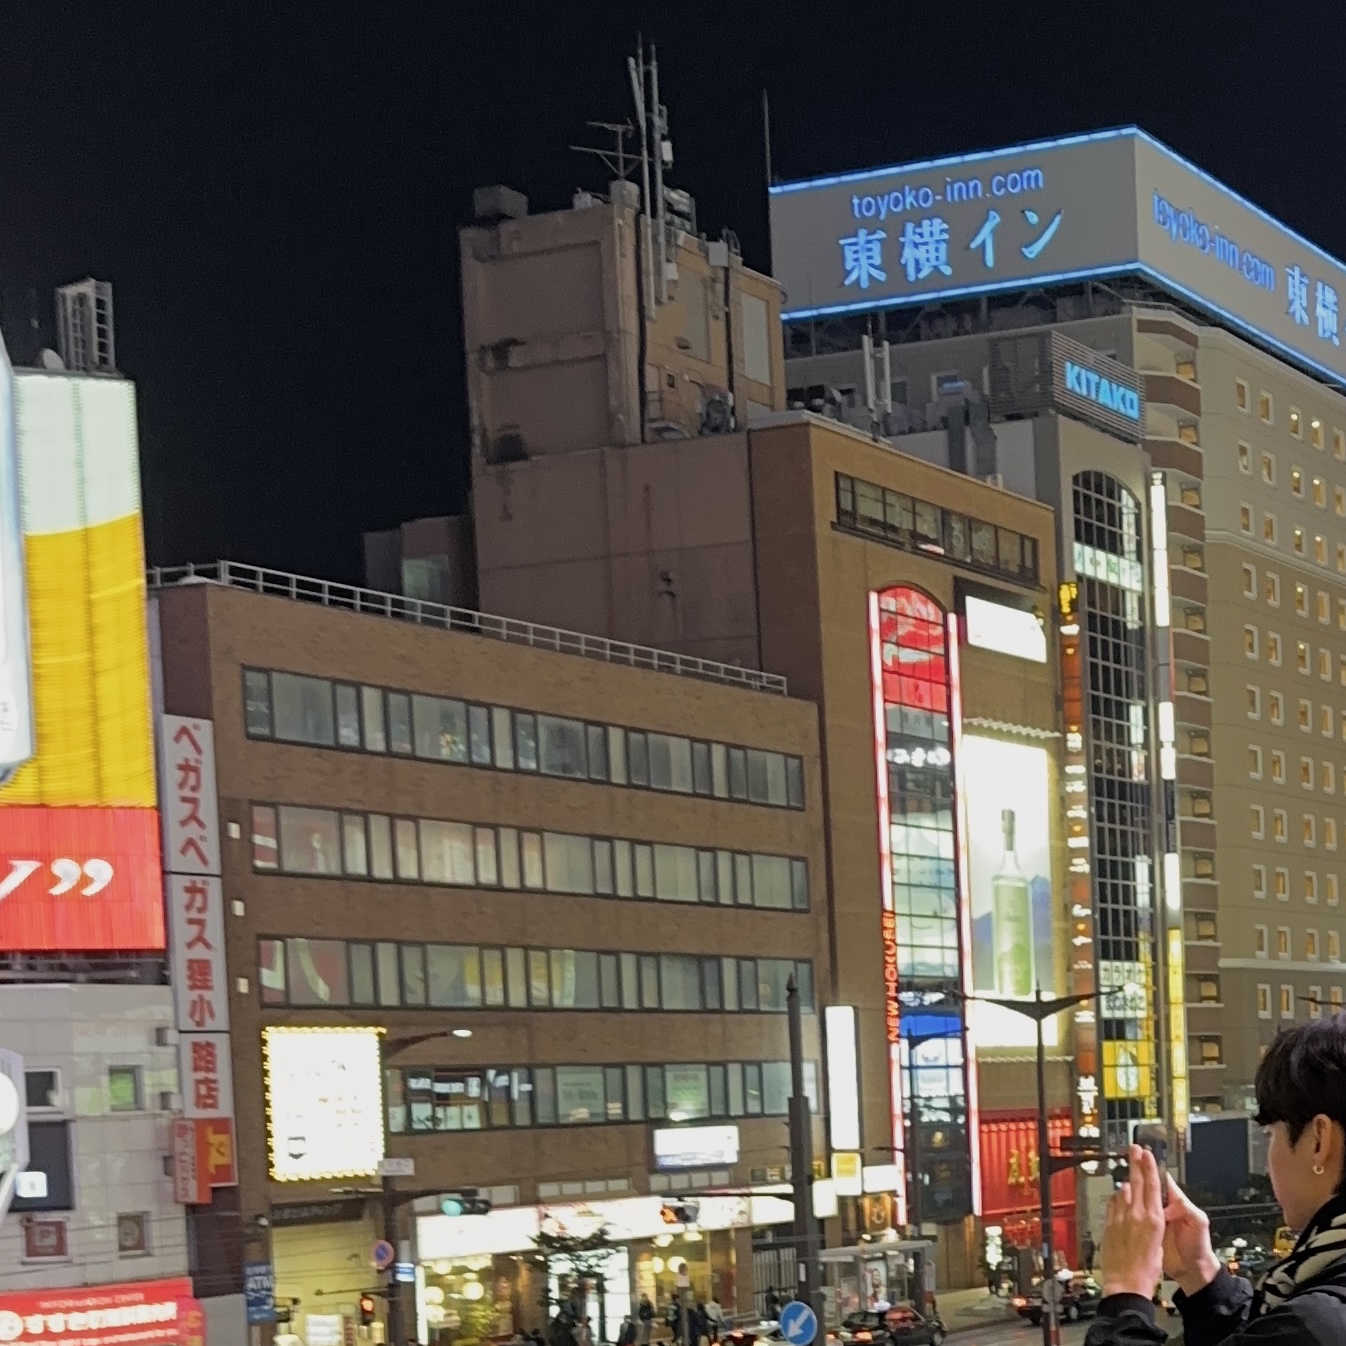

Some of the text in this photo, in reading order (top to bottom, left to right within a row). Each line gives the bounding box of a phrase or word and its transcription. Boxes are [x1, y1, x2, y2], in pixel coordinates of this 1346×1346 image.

[851, 165, 1044, 221] toyoko-inn.com
[839, 208, 1064, 289] 東横イン
[1152, 188, 1275, 291] toyoko-inn.com
[1065, 360, 1139, 420] KITAKO
